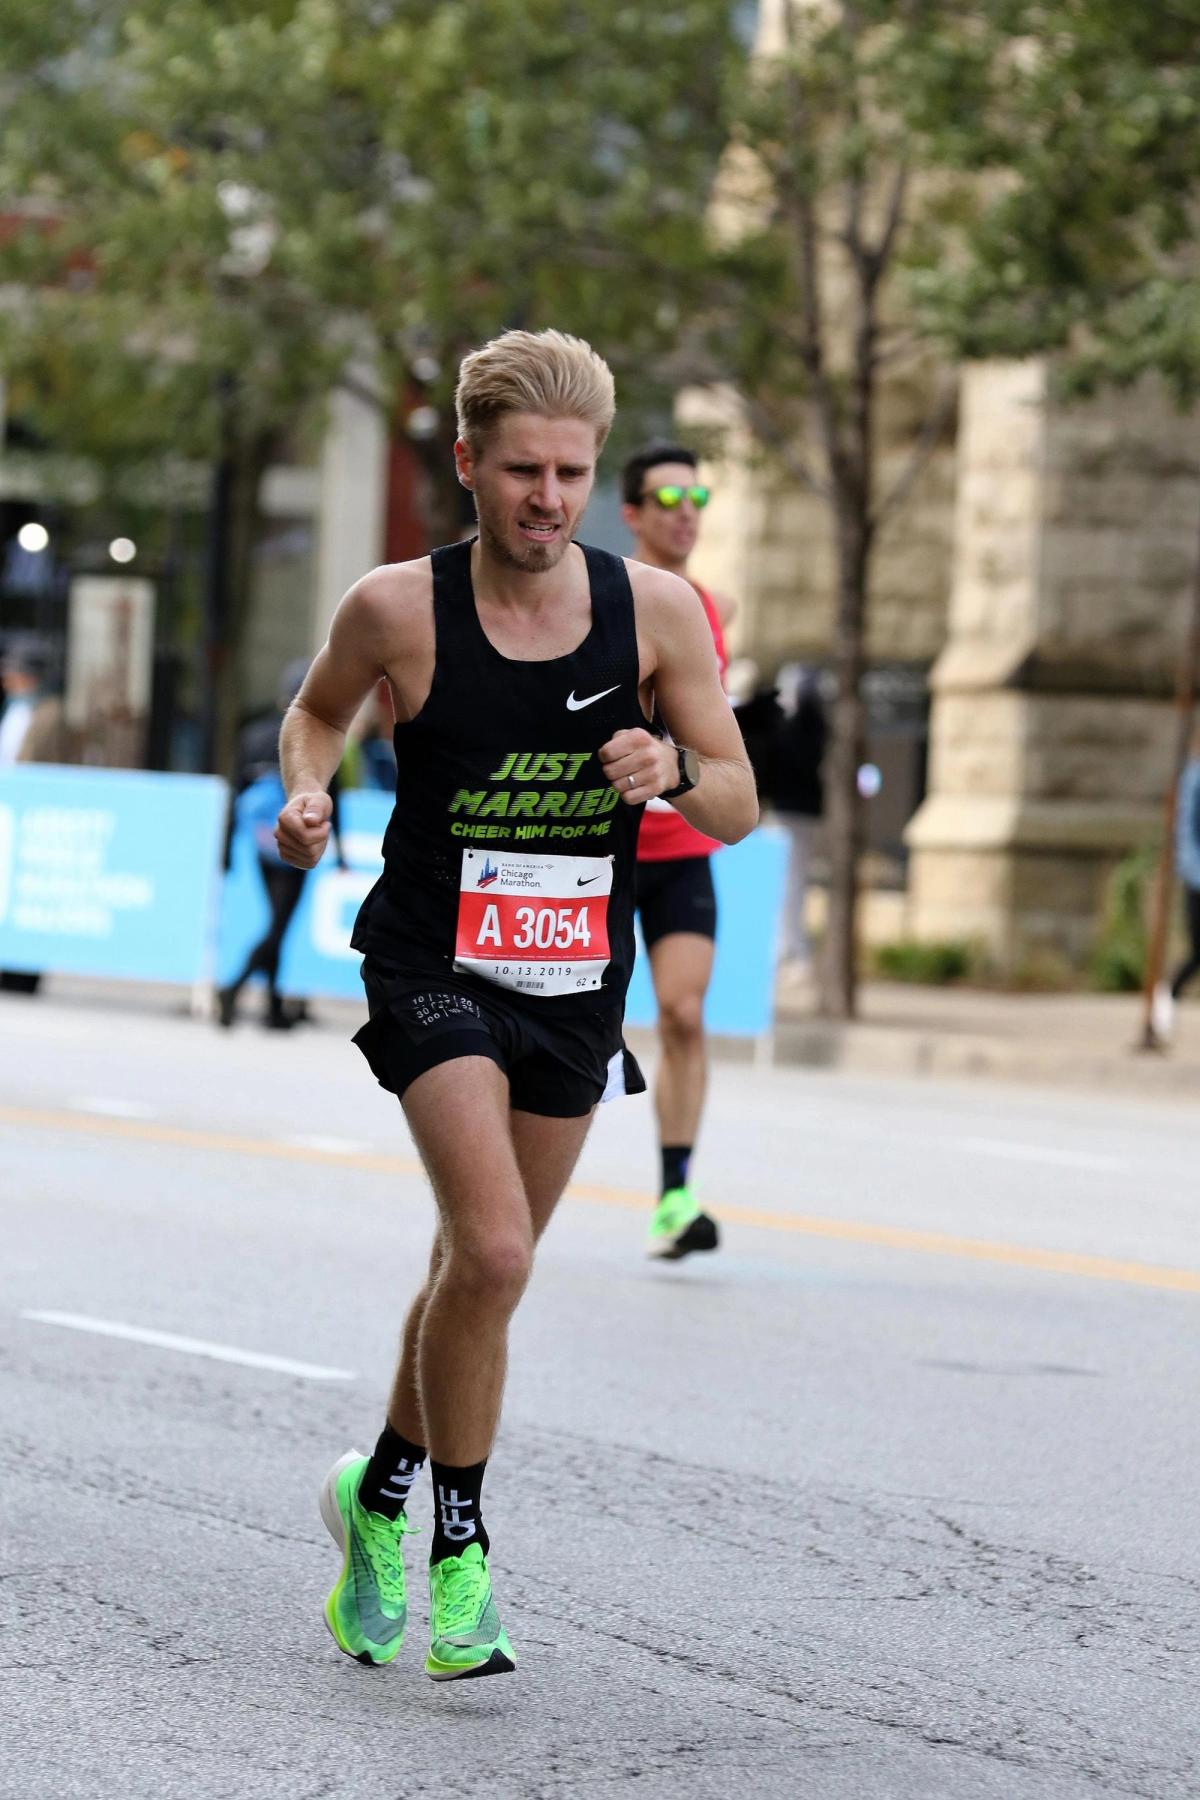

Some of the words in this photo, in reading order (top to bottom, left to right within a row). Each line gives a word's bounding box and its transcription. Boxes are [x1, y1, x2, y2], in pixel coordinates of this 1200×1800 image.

[488, 752, 593, 782] JUST
[449, 786, 620, 818] MARRIED
[450, 821, 512, 839] CHEER
[514, 824, 548, 840] HIM
[549, 824, 587, 840] FOR
[587, 819, 613, 836] ME
[500, 868, 534, 881] Chicago
[476, 904, 503, 947] A
[513, 905, 593, 949] 3054
[494, 965, 573, 977] 10.13.2019
[575, 977, 587, 987] 62
[438, 1484, 477, 1541] OFF
